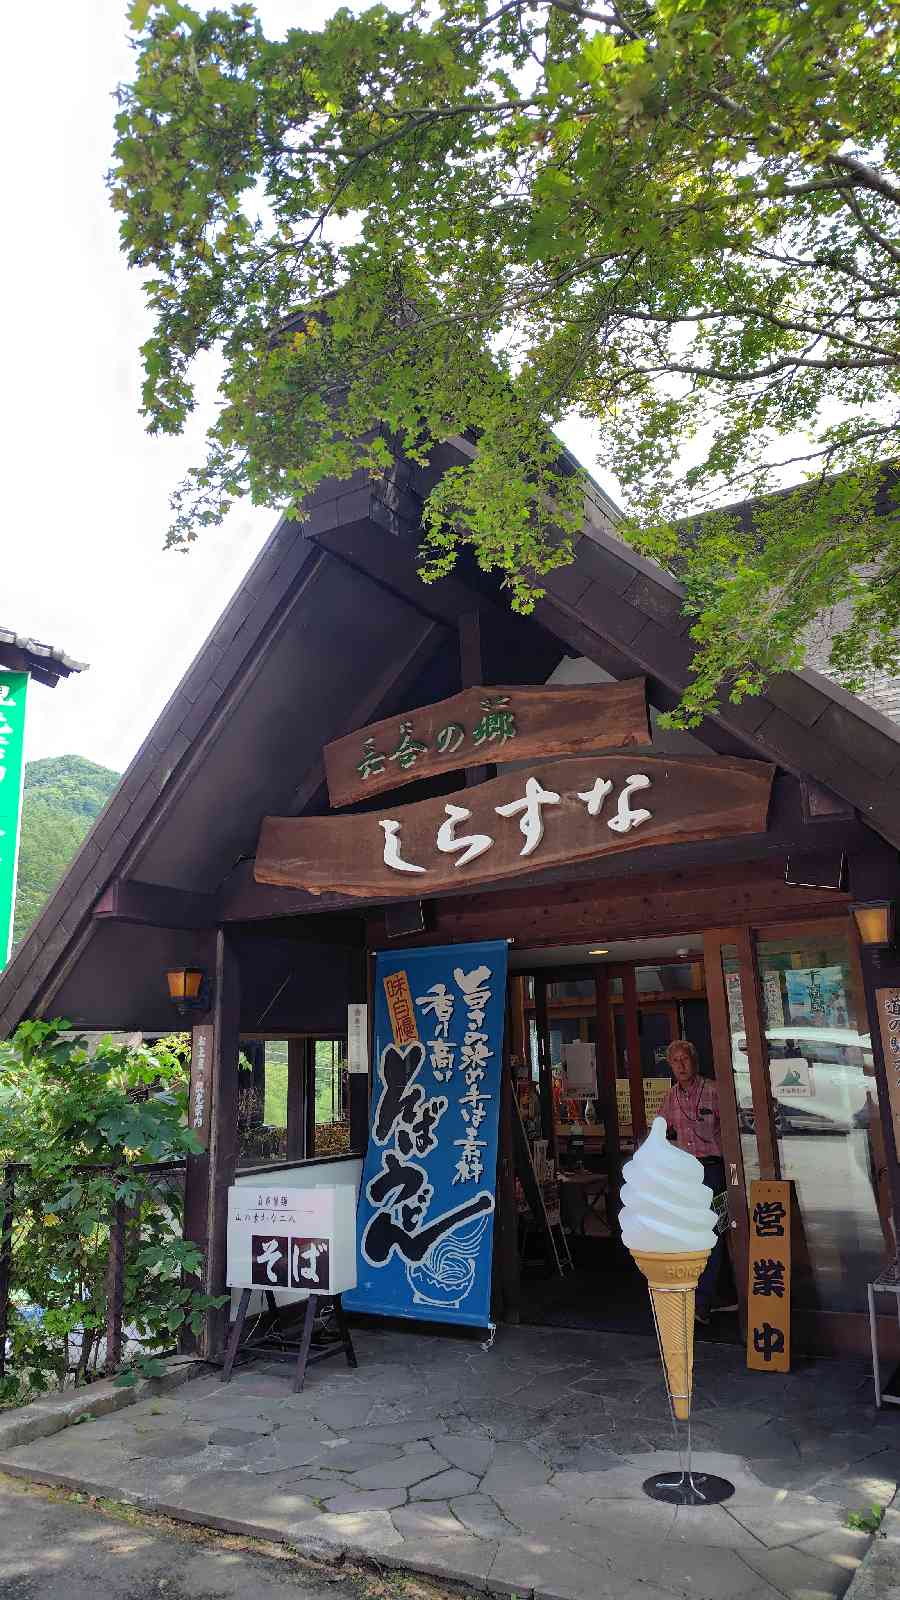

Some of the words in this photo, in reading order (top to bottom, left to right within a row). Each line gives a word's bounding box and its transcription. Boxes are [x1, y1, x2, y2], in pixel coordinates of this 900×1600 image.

[378, 774, 653, 874] しらすな
[386, 974, 417, 1043] 味自慢
[415, 983, 457, 1082] 香り高い
[452, 965, 494, 1185] 旨さの決め手は素材
[256, 1238, 328, 1283] そば
[752, 1200, 786, 1362] 営業中
